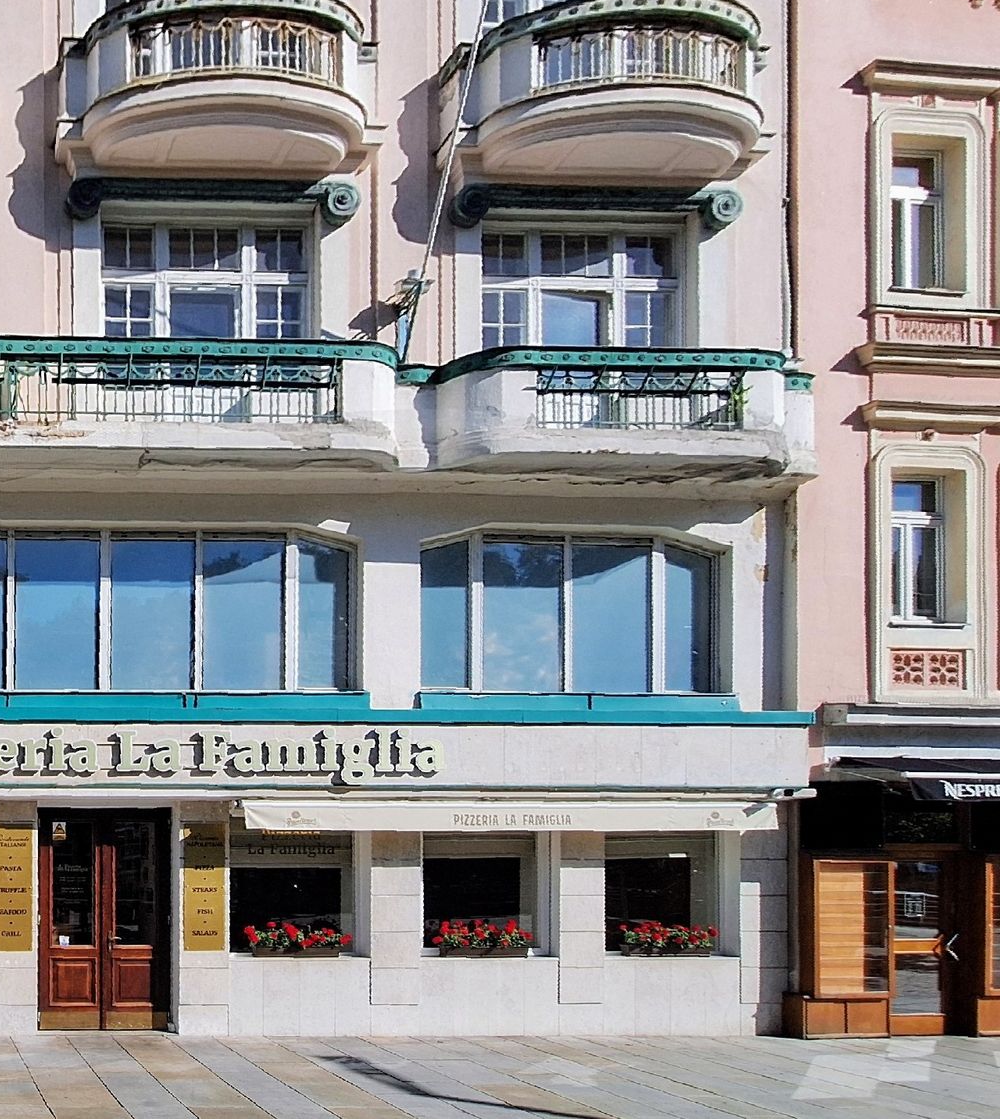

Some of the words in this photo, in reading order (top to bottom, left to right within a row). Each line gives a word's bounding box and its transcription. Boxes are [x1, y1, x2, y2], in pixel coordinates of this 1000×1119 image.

[116, 729, 182, 773] La
[200, 728, 447, 784] Famiglia
[453, 814, 499, 826] PIZZERIA
[505, 814, 517, 826] LA
[523, 814, 572, 826] FAMIGLIA
[247, 843, 265, 855] La
[270, 843, 335, 857] Famiglia
